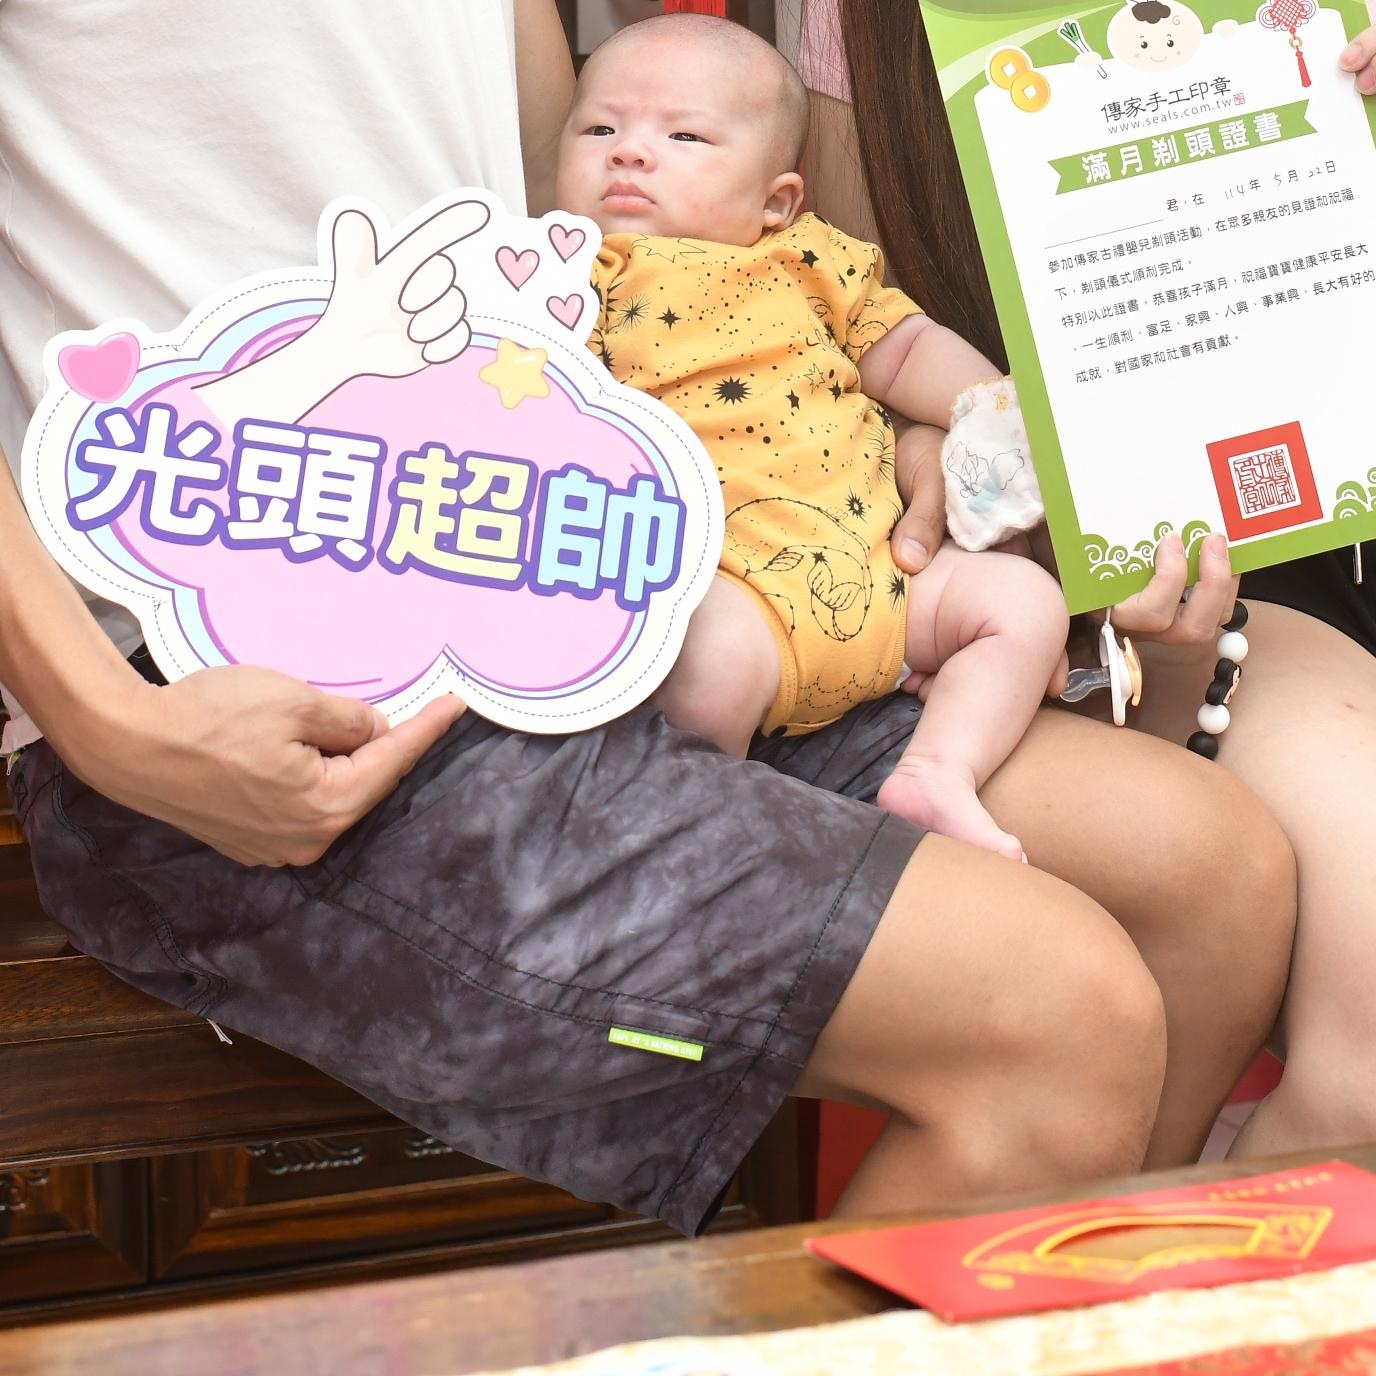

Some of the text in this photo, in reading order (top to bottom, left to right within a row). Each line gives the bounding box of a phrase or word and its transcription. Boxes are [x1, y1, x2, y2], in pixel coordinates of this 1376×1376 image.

[1101, 76, 1231, 123] 傳家手工印章
[1108, 98, 1232, 134] www.seals.com.tw
[1081, 112, 1282, 184] 滿月剃頭證書
[66, 401, 687, 612] 光頭超帥
